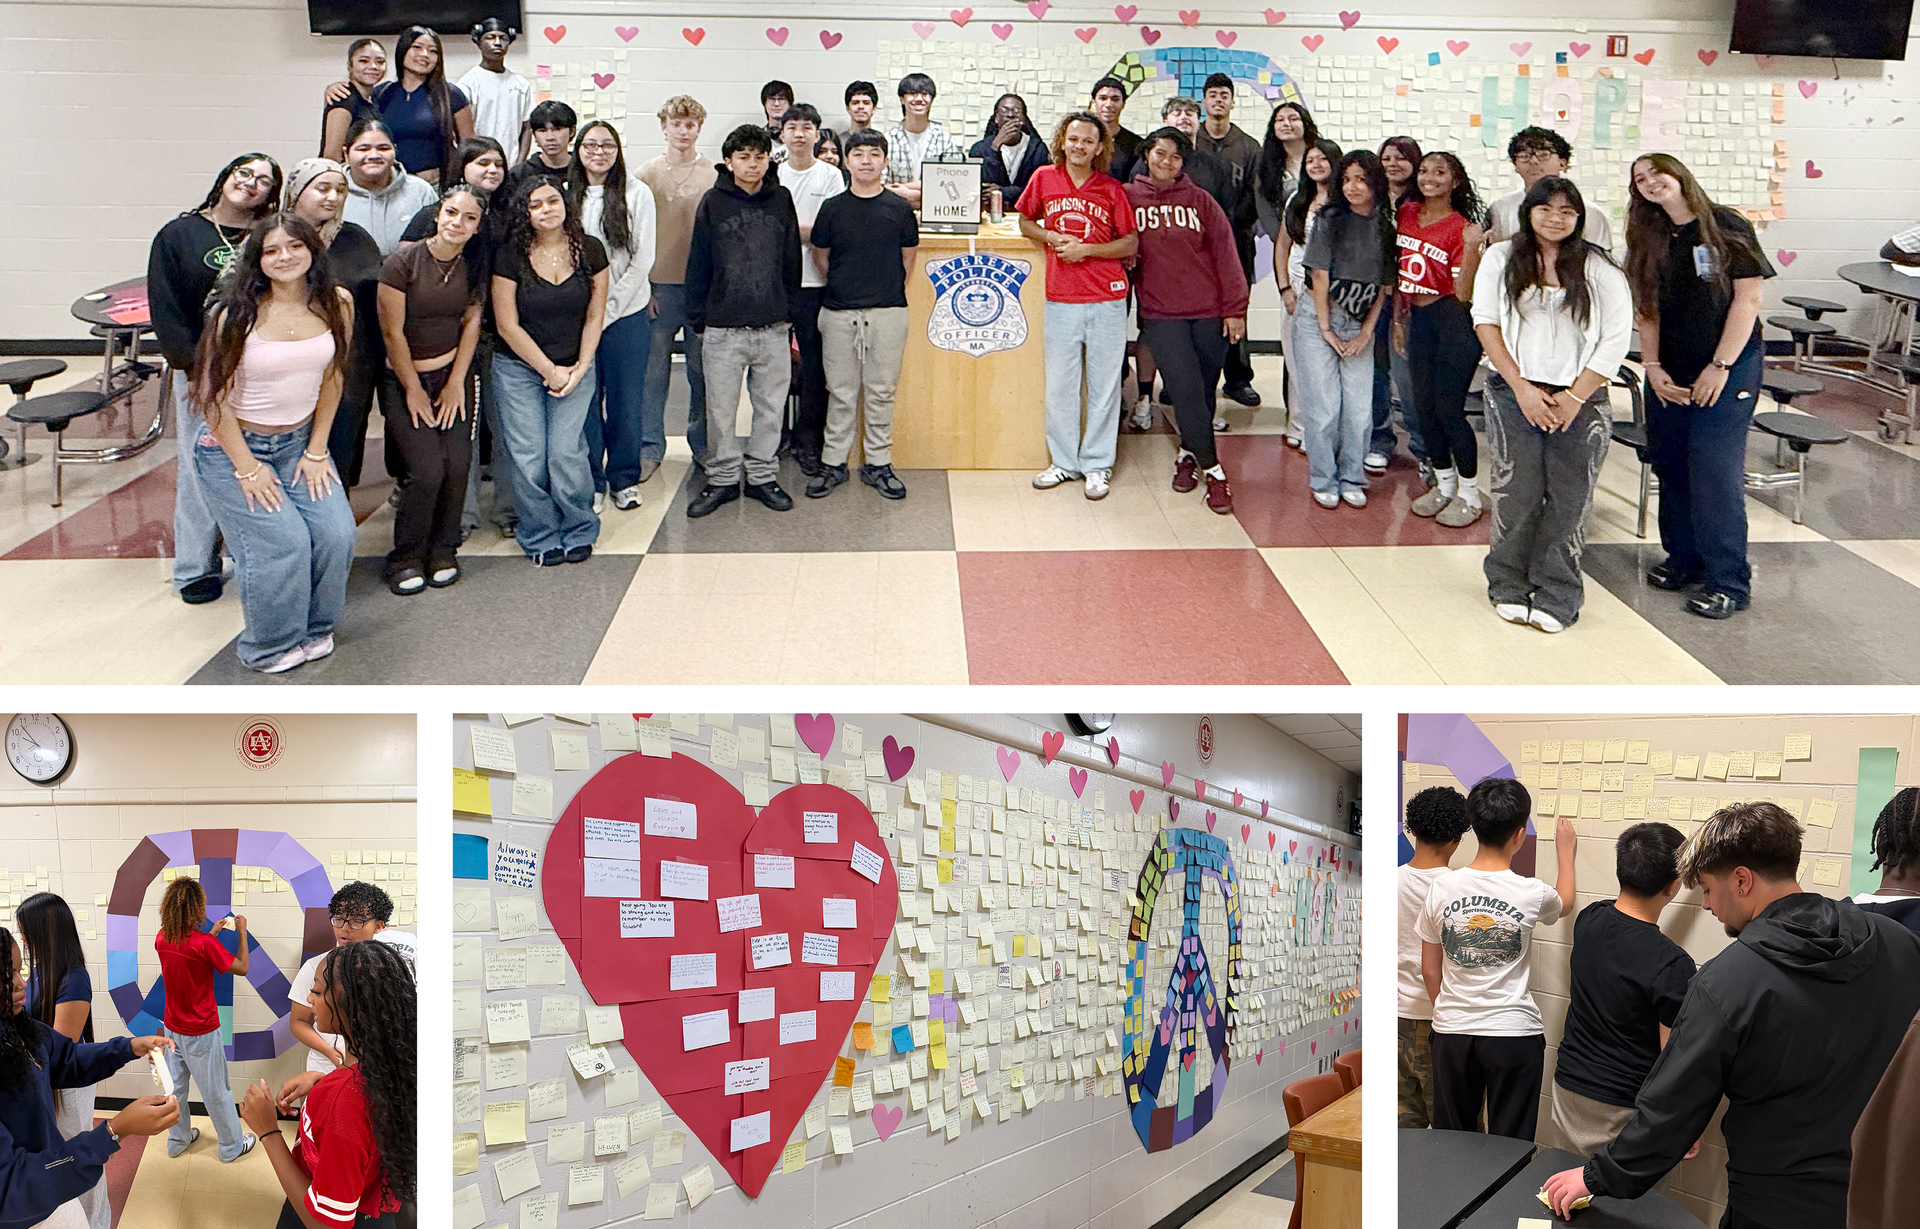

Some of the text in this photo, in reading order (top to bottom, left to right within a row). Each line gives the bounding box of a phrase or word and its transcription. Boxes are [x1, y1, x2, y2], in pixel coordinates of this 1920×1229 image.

[1482, 76, 1687, 150] HOPE
[936, 167, 969, 177] Phone
[933, 205, 968, 217] HOME
[1135, 205, 1201, 232] OSTON
[934, 255, 1021, 278] EVERETT
[941, 268, 1013, 289] POLICE
[944, 330, 1010, 340] OFFICER
[20, 717, 27, 725] 11
[31, 713, 40, 721] 12
[11, 728, 21, 737] 10
[55, 726, 60, 734] 2
[11, 742, 16, 750] 9
[59, 739, 64, 748] 3
[15, 755, 21, 764] 8
[25, 765, 30, 773] 7
[37, 768, 42, 776] 6
[497, 841, 529, 857] Always
[1443, 895, 1525, 923] COLUMBIA
[1462, 907, 1494, 915] Sportswear
[823, 979, 847, 990] PEACE
[597, 1143, 621, 1152] HEAVEN
